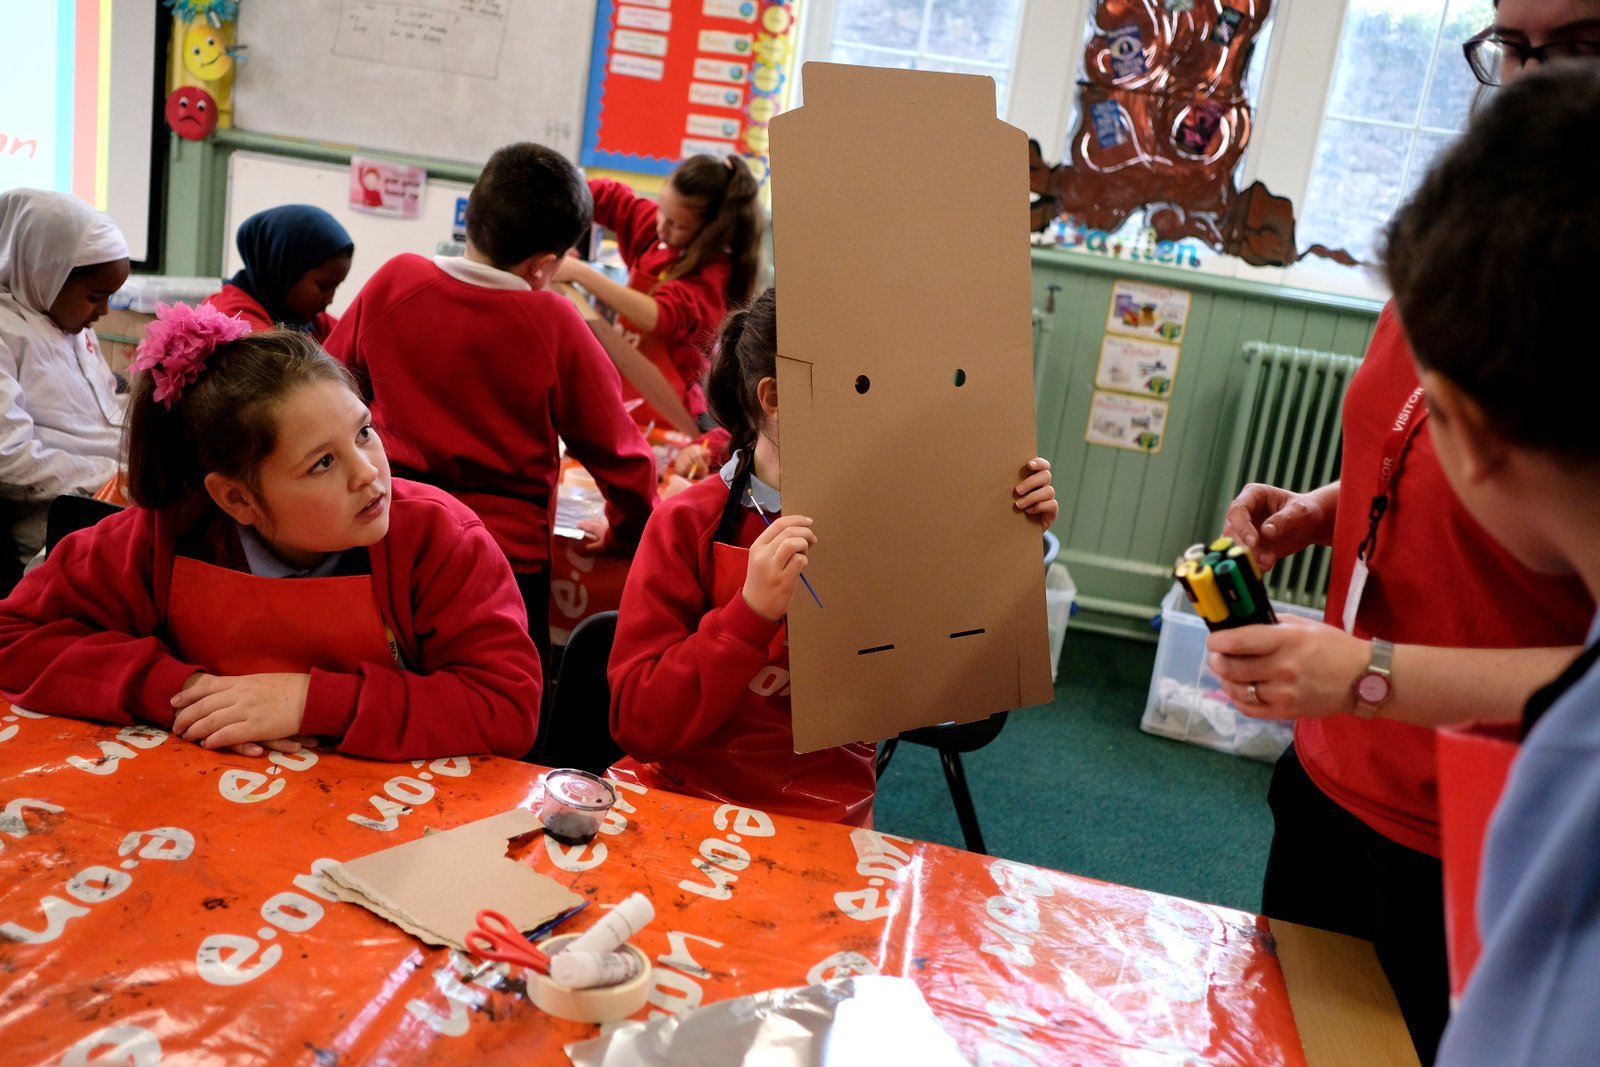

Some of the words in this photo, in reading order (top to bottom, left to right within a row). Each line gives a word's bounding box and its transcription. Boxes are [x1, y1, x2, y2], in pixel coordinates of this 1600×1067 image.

[1392, 385, 1425, 431] VISITOR
[219, 749, 319, 804] e.o
[0, 827, 196, 944] e.on
[678, 803, 776, 900] e.on
[834, 828, 915, 921] e.on
